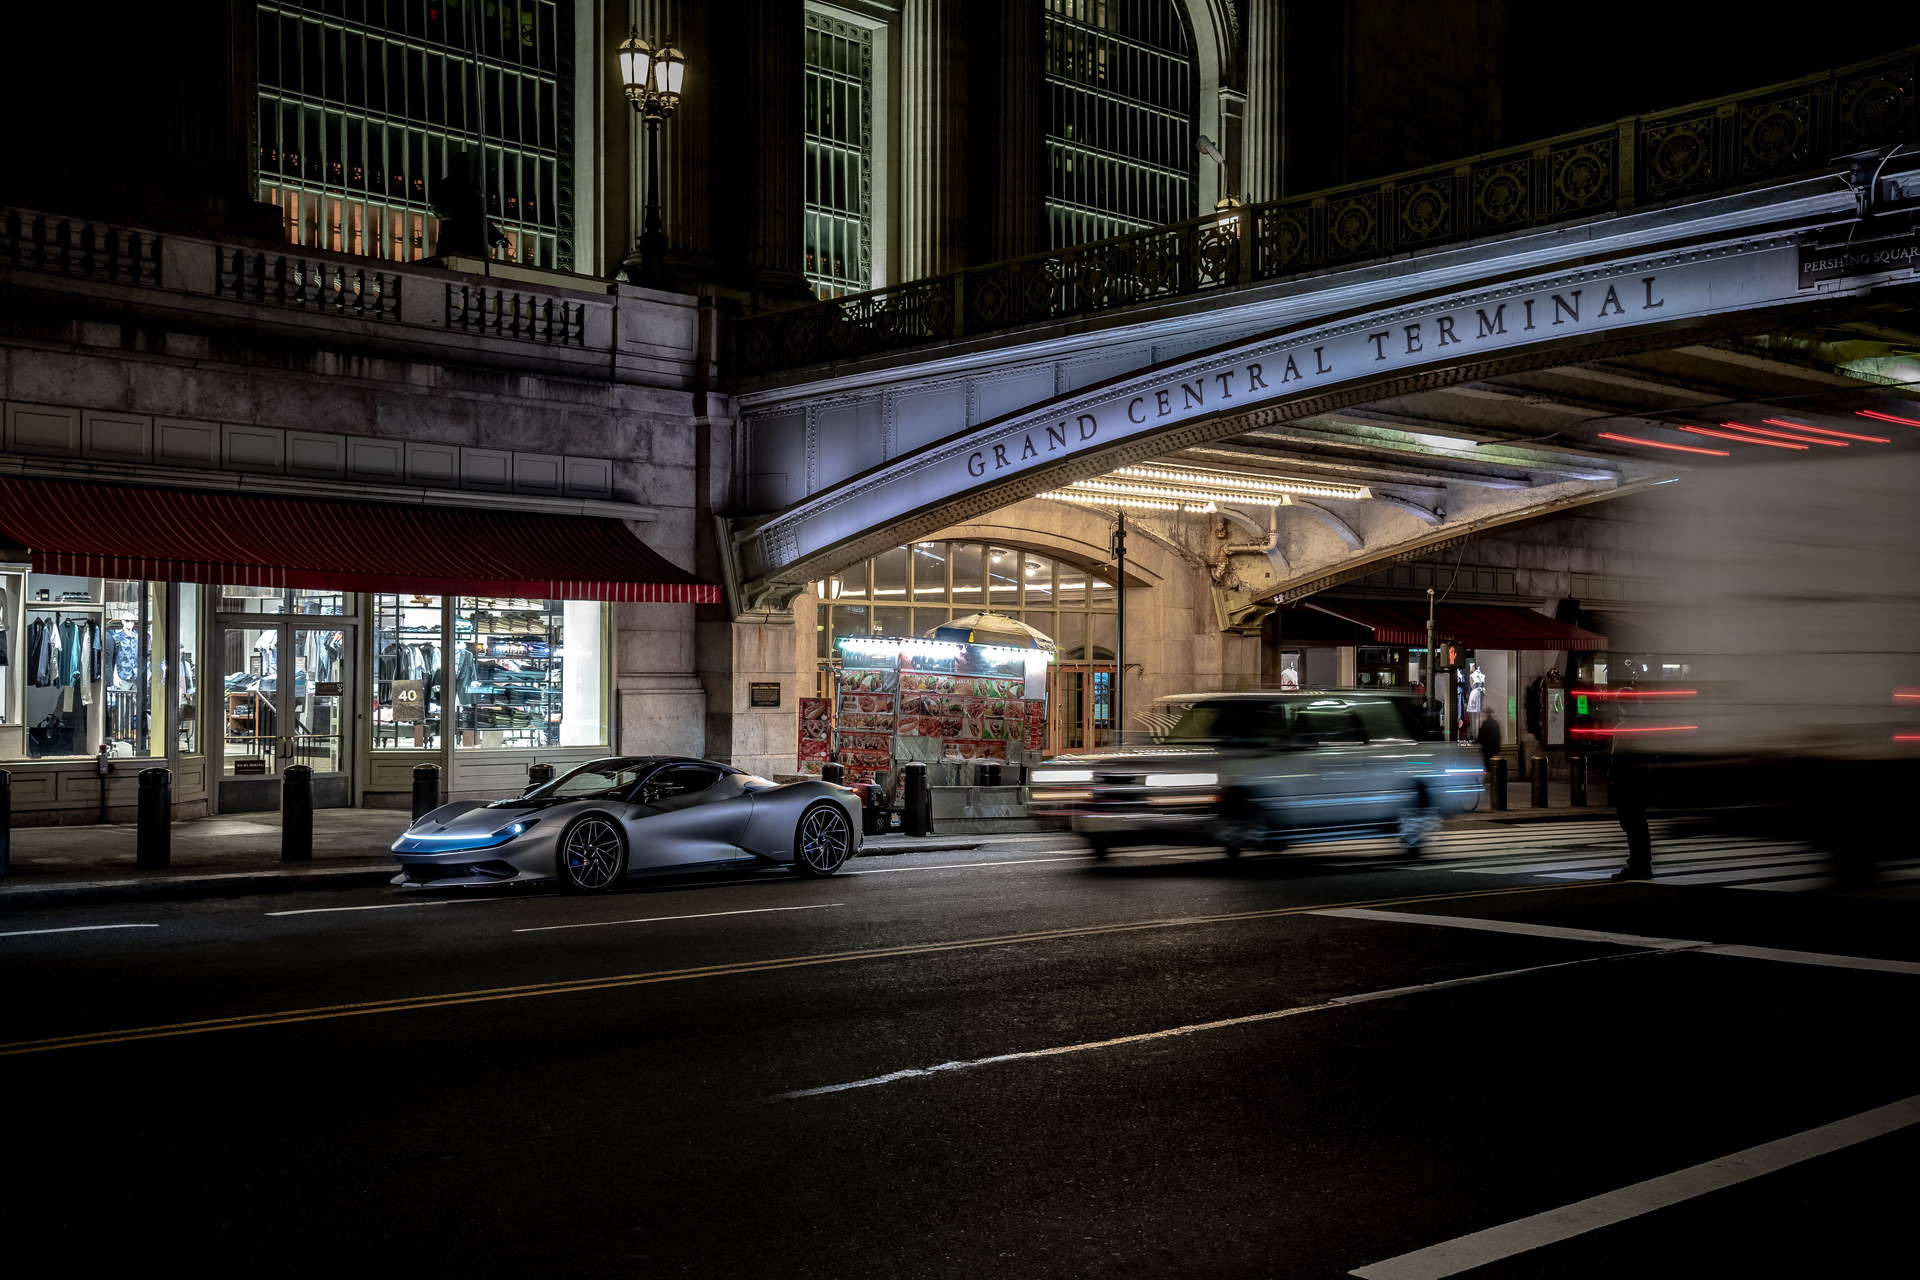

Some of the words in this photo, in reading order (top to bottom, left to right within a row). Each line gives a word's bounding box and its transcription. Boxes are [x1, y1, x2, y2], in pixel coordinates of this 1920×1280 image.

[1803, 253, 1870, 273] PERSHING
[1873, 246, 1920, 263] SQUAR
[967, 414, 1098, 477] GRAND
[1127, 346, 1333, 424] CENTRAL
[1368, 277, 1665, 361] TERMINAL
[397, 689, 418, 702] 40
